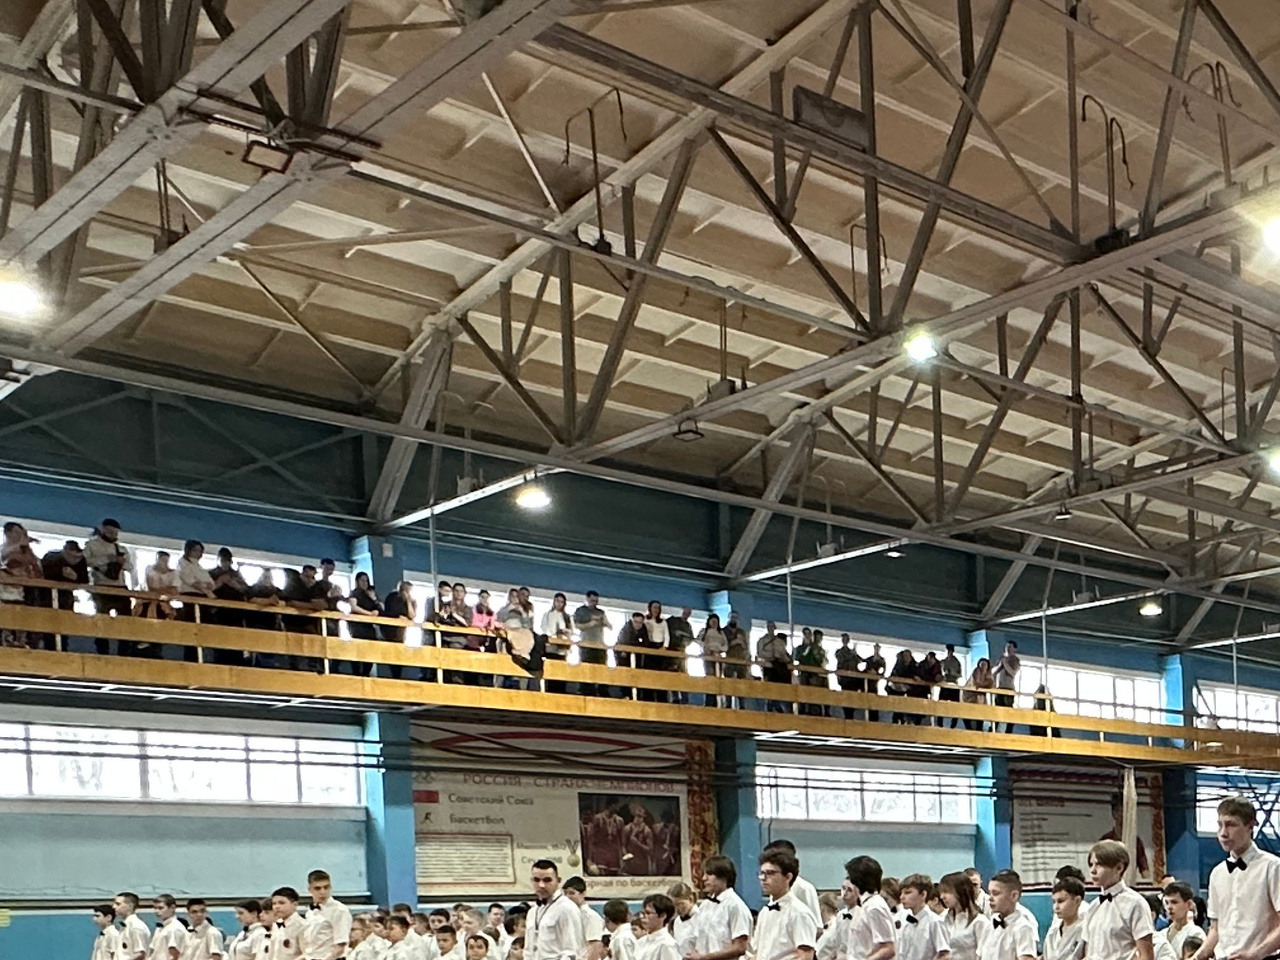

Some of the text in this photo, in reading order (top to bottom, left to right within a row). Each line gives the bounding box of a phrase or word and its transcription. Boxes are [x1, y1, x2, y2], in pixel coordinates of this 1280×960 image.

[463, 773, 522, 787] РОССИЯ
[448, 792, 504, 804] Советский
[449, 813, 505, 825] Баскетбол
